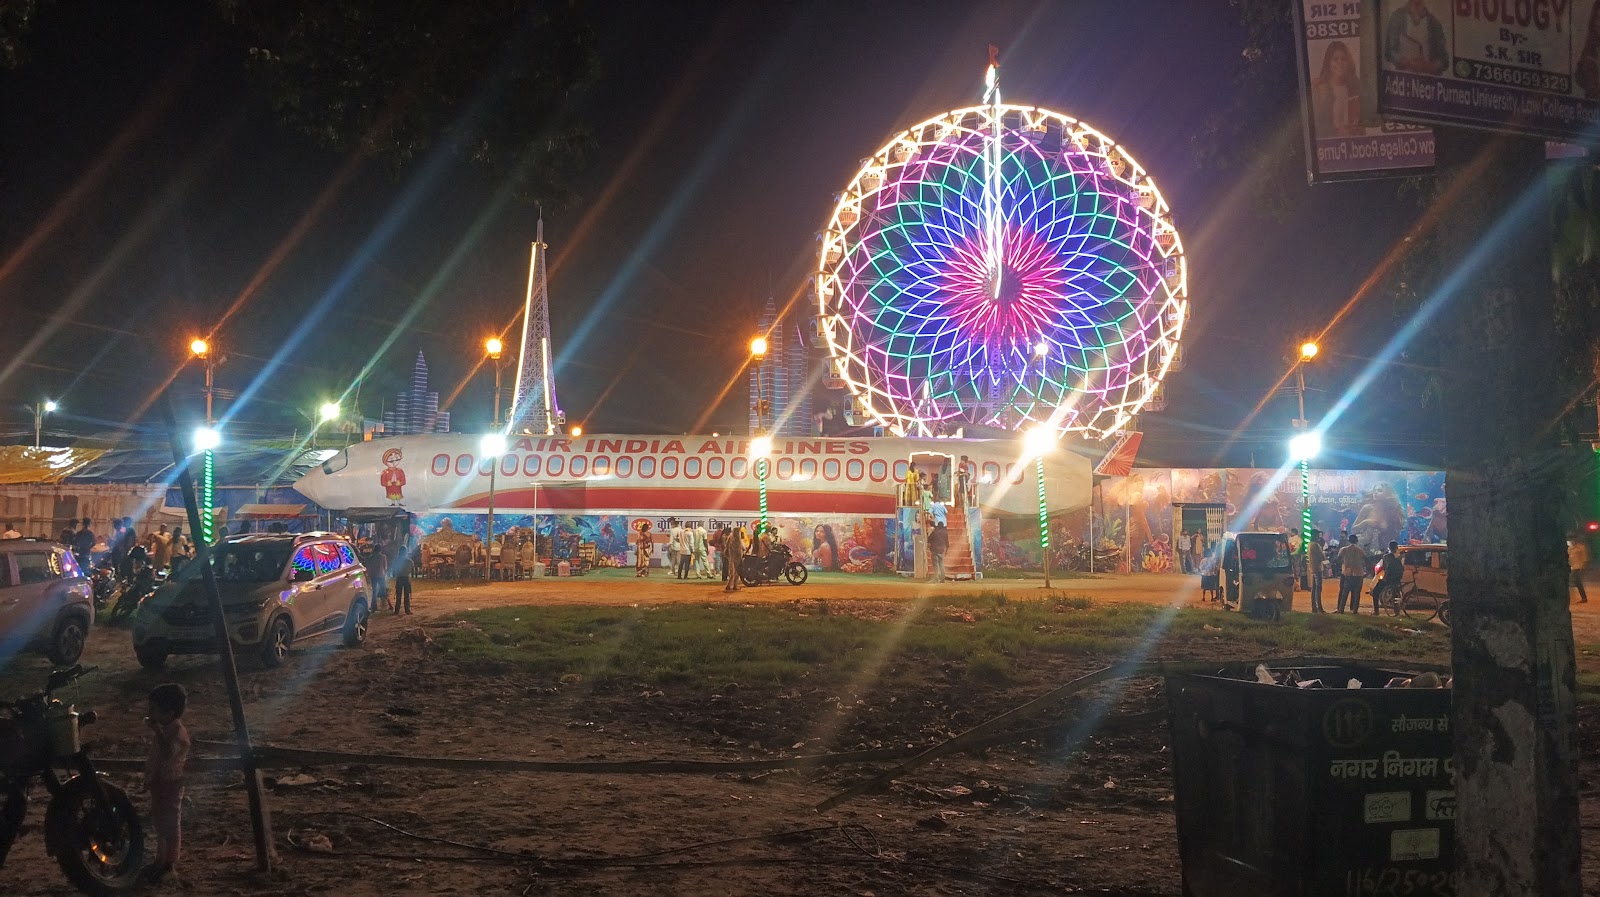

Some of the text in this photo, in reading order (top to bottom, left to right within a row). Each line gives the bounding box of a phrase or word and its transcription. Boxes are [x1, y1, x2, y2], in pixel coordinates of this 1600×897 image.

[1517, 49, 1542, 67] SIR
[1473, 63, 1568, 91] 7366059329
[1411, 79, 1435, 100] Near
[1437, 82, 1471, 105] Purnea
[511, 438, 572, 453] AIR
[585, 439, 686, 454] INDIA
[1329, 758, 1379, 779] नगर
[1382, 750, 1440, 778] निगम
